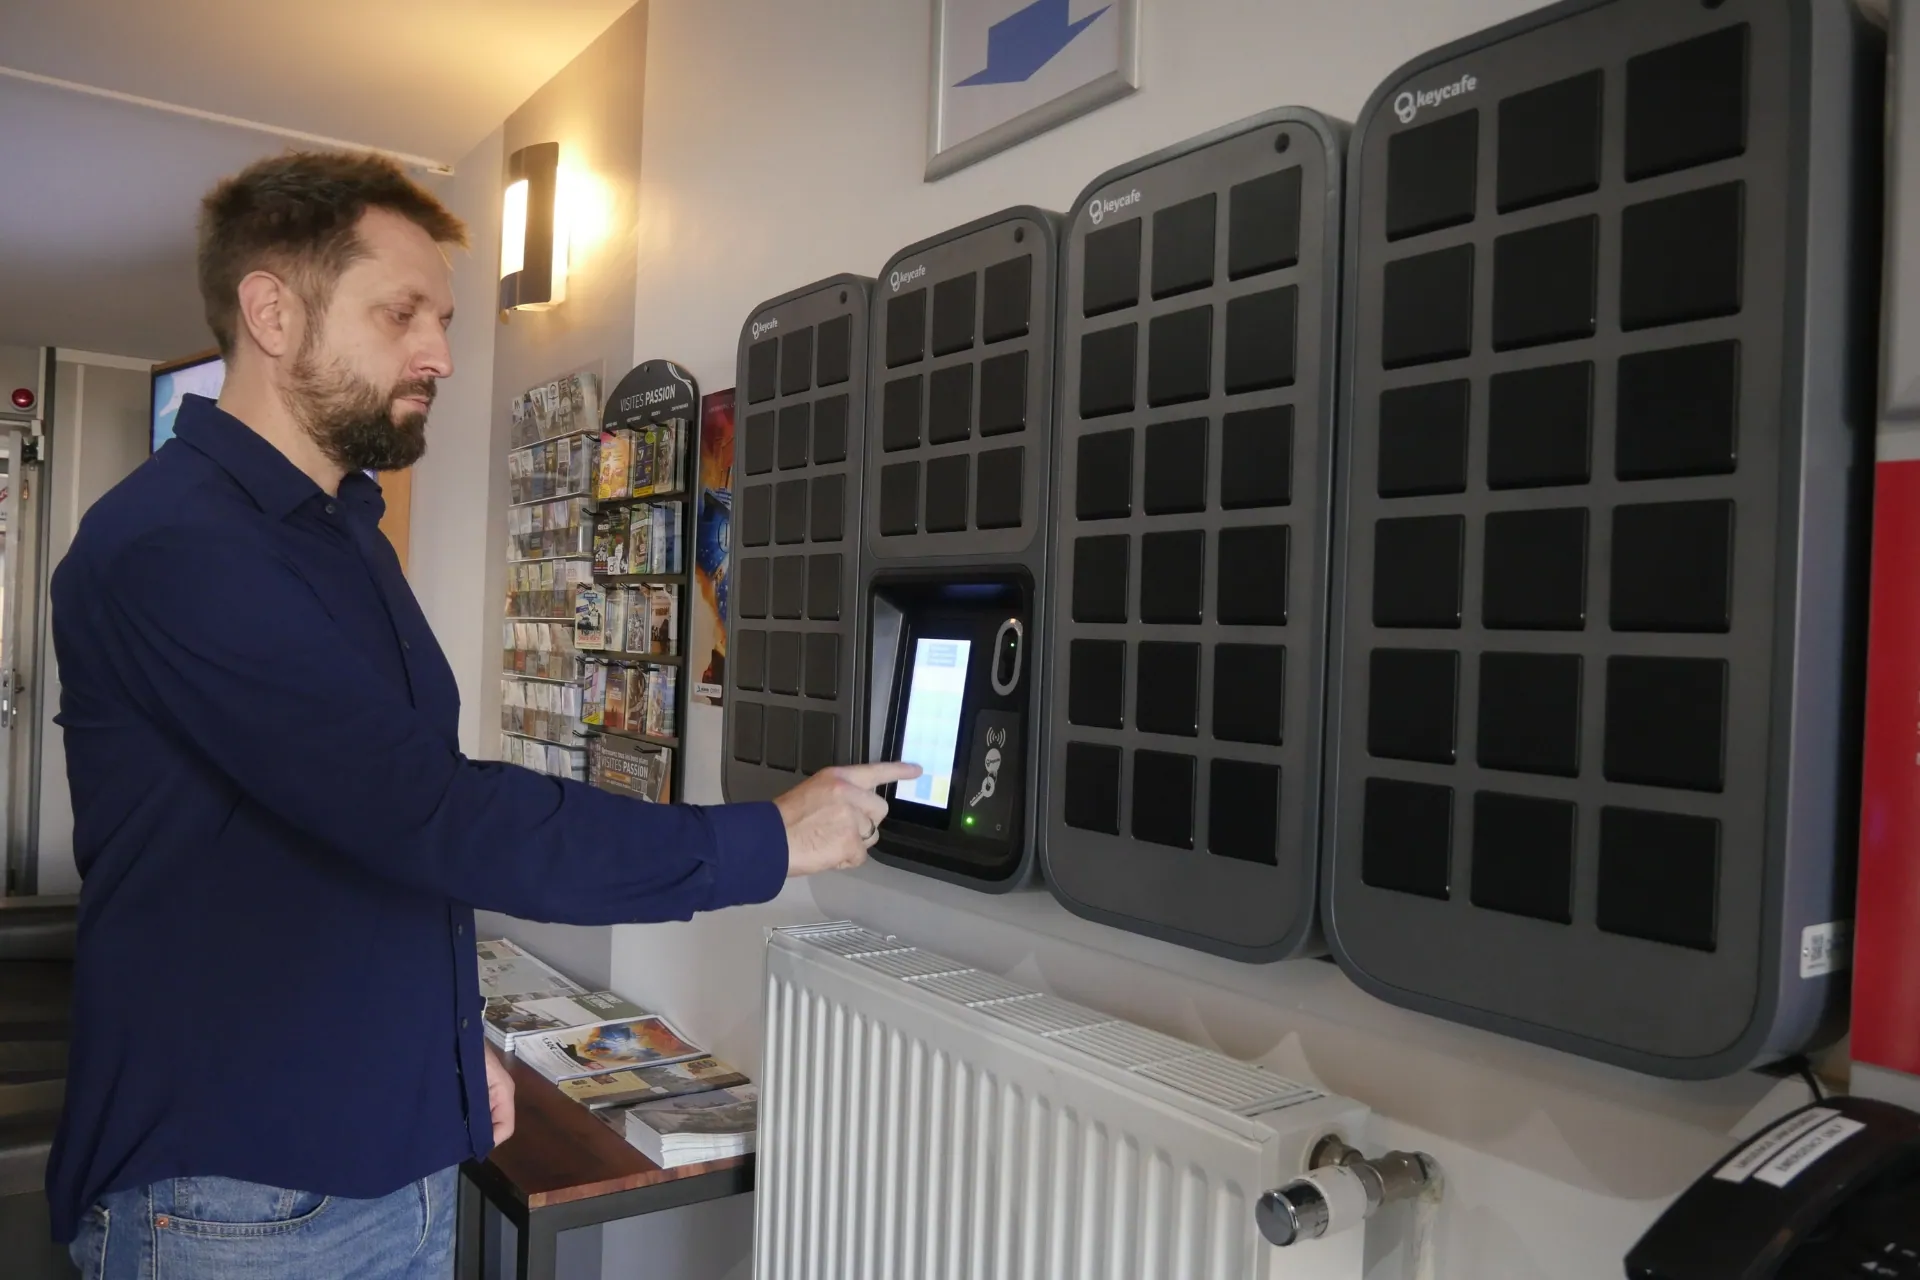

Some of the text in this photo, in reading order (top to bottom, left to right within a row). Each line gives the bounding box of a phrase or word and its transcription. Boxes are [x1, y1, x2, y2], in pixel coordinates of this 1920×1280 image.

[1416, 74, 1478, 108] keycafe
[1103, 189, 1141, 213] keycafe
[900, 265, 926, 283] keycafe
[759, 317, 778, 333] keycafe
[620, 384, 676, 412] VISITES PASSION
[602, 756, 622, 772] VISITES
[622, 761, 649, 779] PASSION
